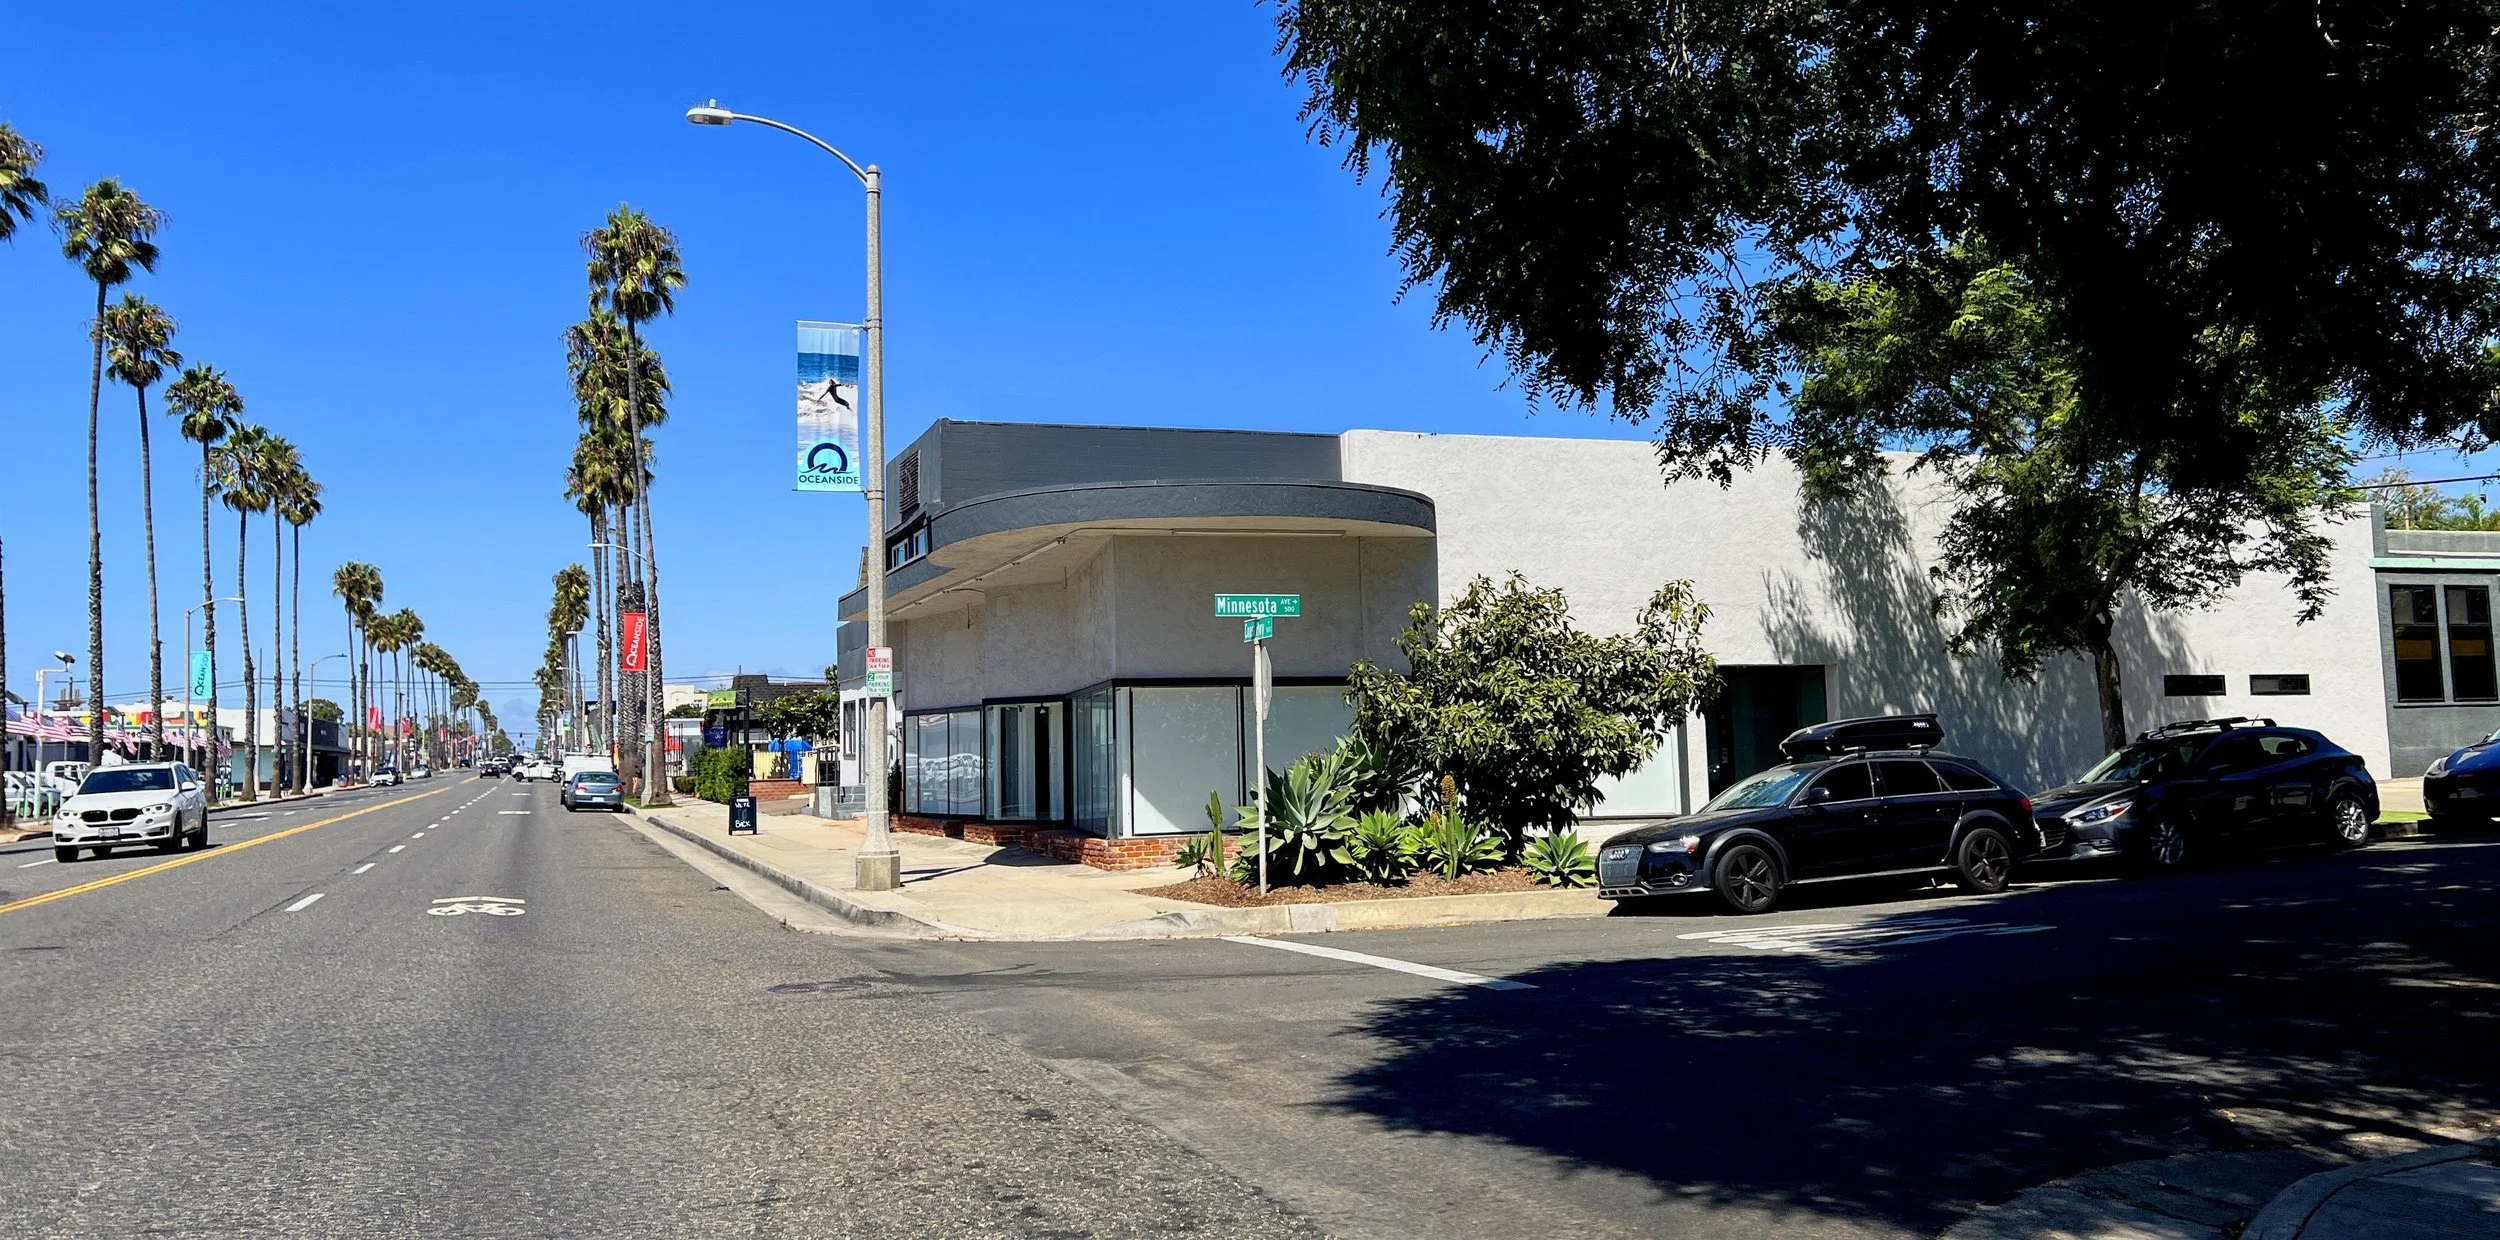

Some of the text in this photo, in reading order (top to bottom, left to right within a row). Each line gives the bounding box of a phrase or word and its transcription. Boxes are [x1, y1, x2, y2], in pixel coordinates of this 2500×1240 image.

[798, 474, 859, 485] OCEANSIDE
[1217, 597, 1277, 614] Minnesota
[1284, 605, 1295, 613] 500
[625, 616, 645, 668] OCEANSIDE
[868, 673, 875, 681] 2
